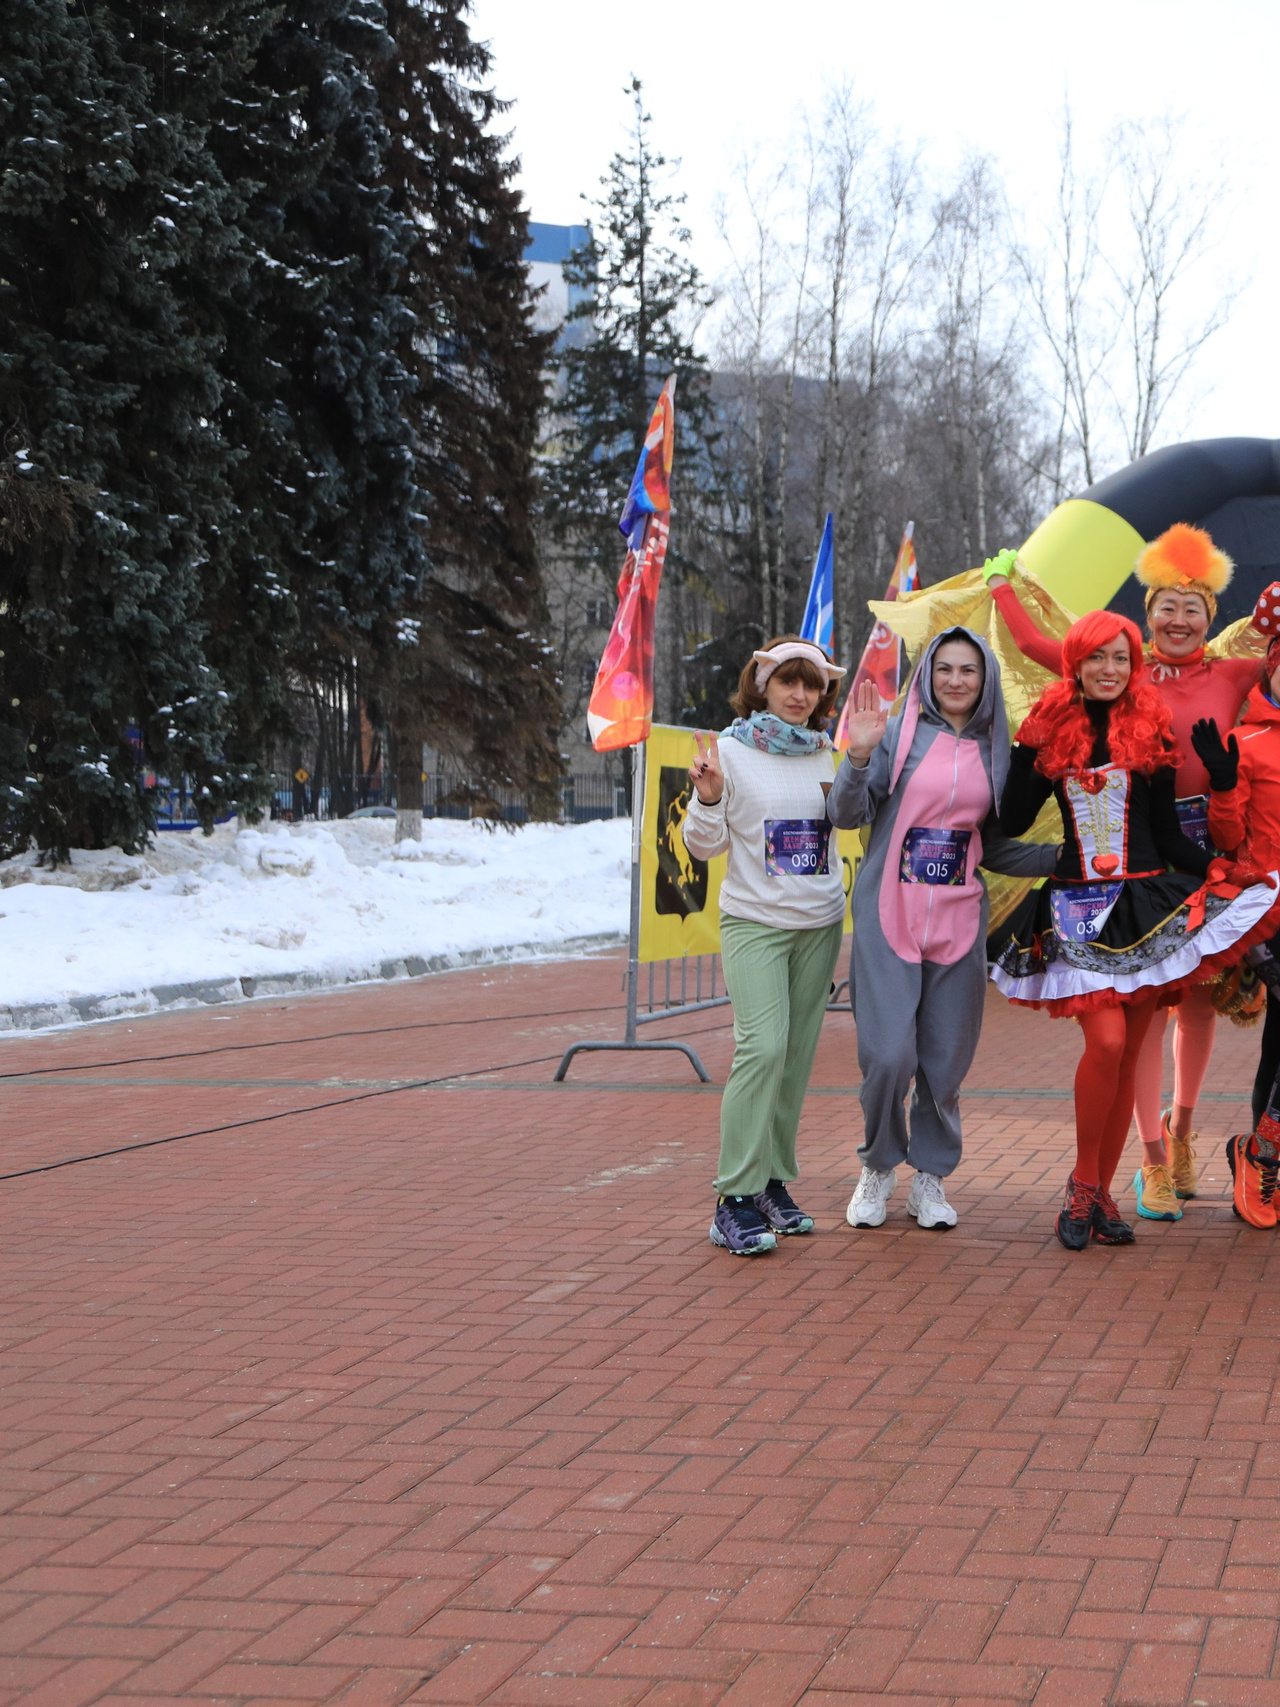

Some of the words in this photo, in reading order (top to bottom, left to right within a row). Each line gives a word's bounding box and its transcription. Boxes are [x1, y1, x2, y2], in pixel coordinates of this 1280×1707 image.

[791, 853, 817, 868] 030
[942, 852, 956, 860] 2023
[926, 862, 949, 877] 015
